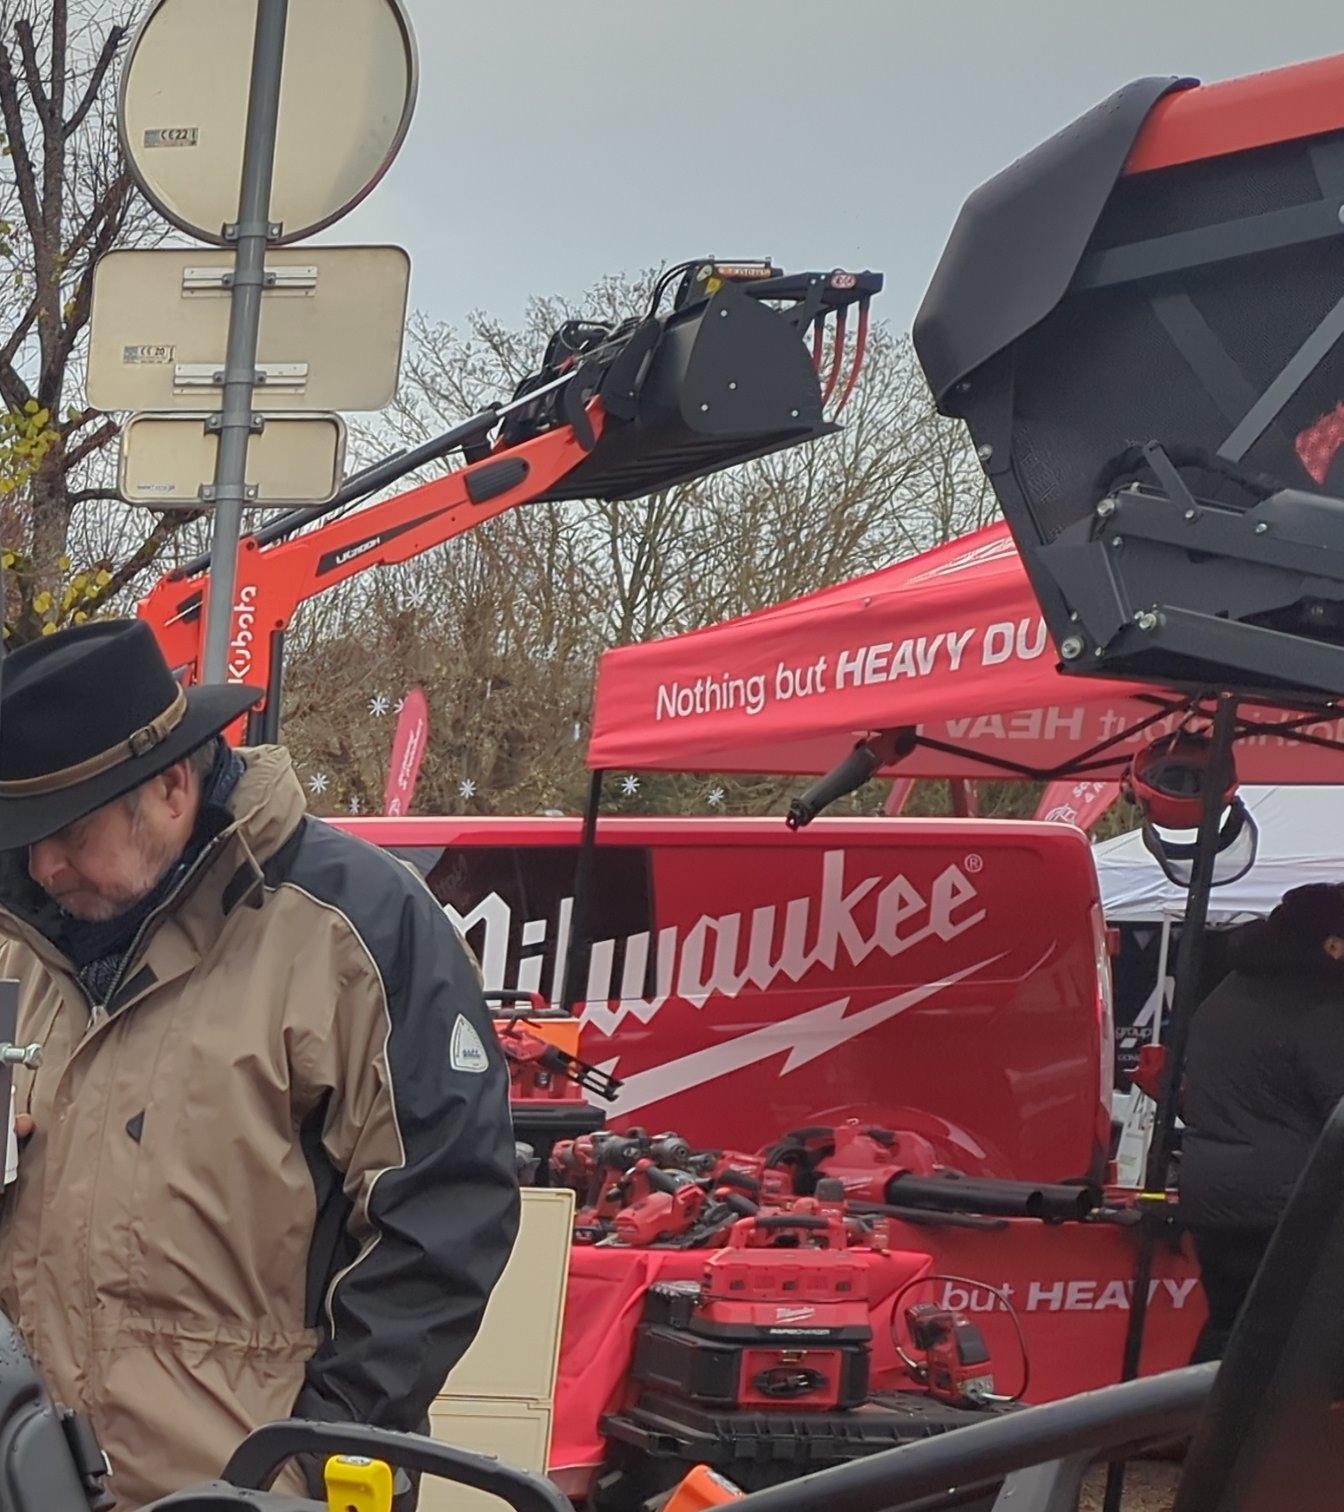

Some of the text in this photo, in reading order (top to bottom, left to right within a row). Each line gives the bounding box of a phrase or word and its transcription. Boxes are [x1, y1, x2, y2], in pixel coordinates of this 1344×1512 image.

[655, 615, 1048, 721] Nothing but HEAVY DU
[941, 1282, 1015, 1312] but
